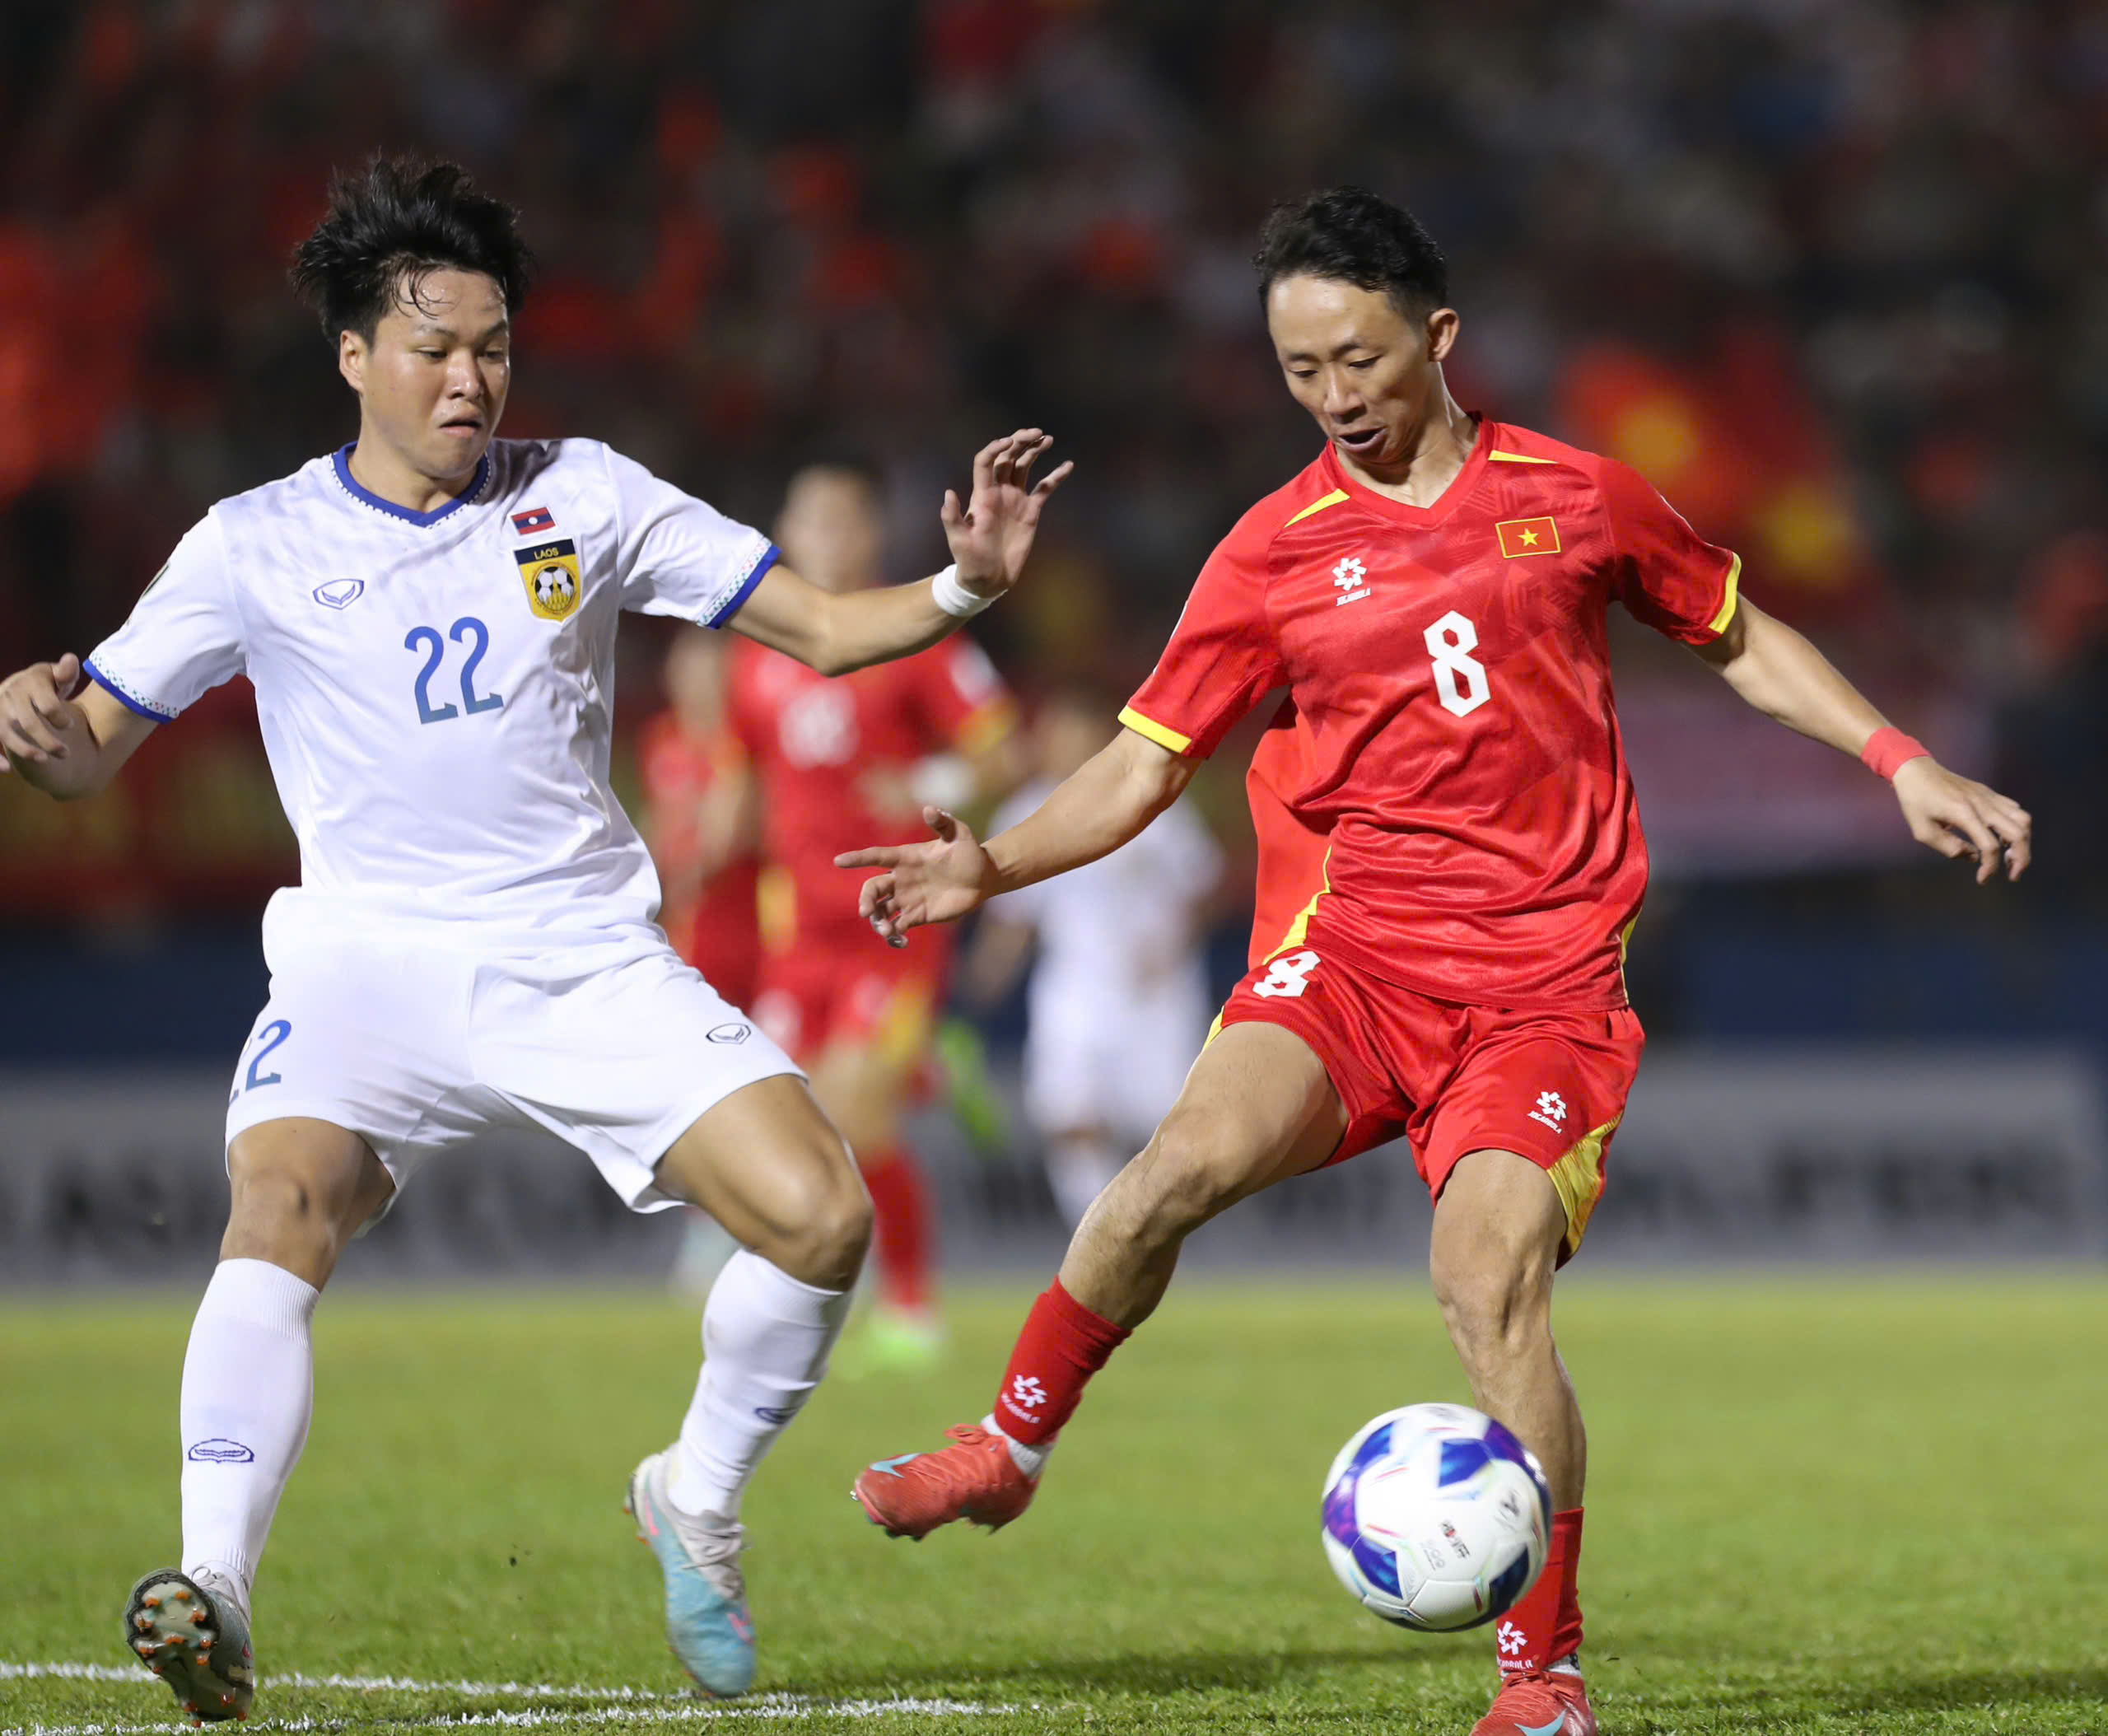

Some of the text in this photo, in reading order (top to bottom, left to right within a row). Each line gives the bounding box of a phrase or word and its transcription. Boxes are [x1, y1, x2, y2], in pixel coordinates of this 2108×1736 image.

[534, 547, 559, 560] LAOS
[404, 616, 504, 725] 22
[1423, 609, 1491, 718] 8
[1252, 950, 1322, 998] 8
[229, 1019, 292, 1106] 2
